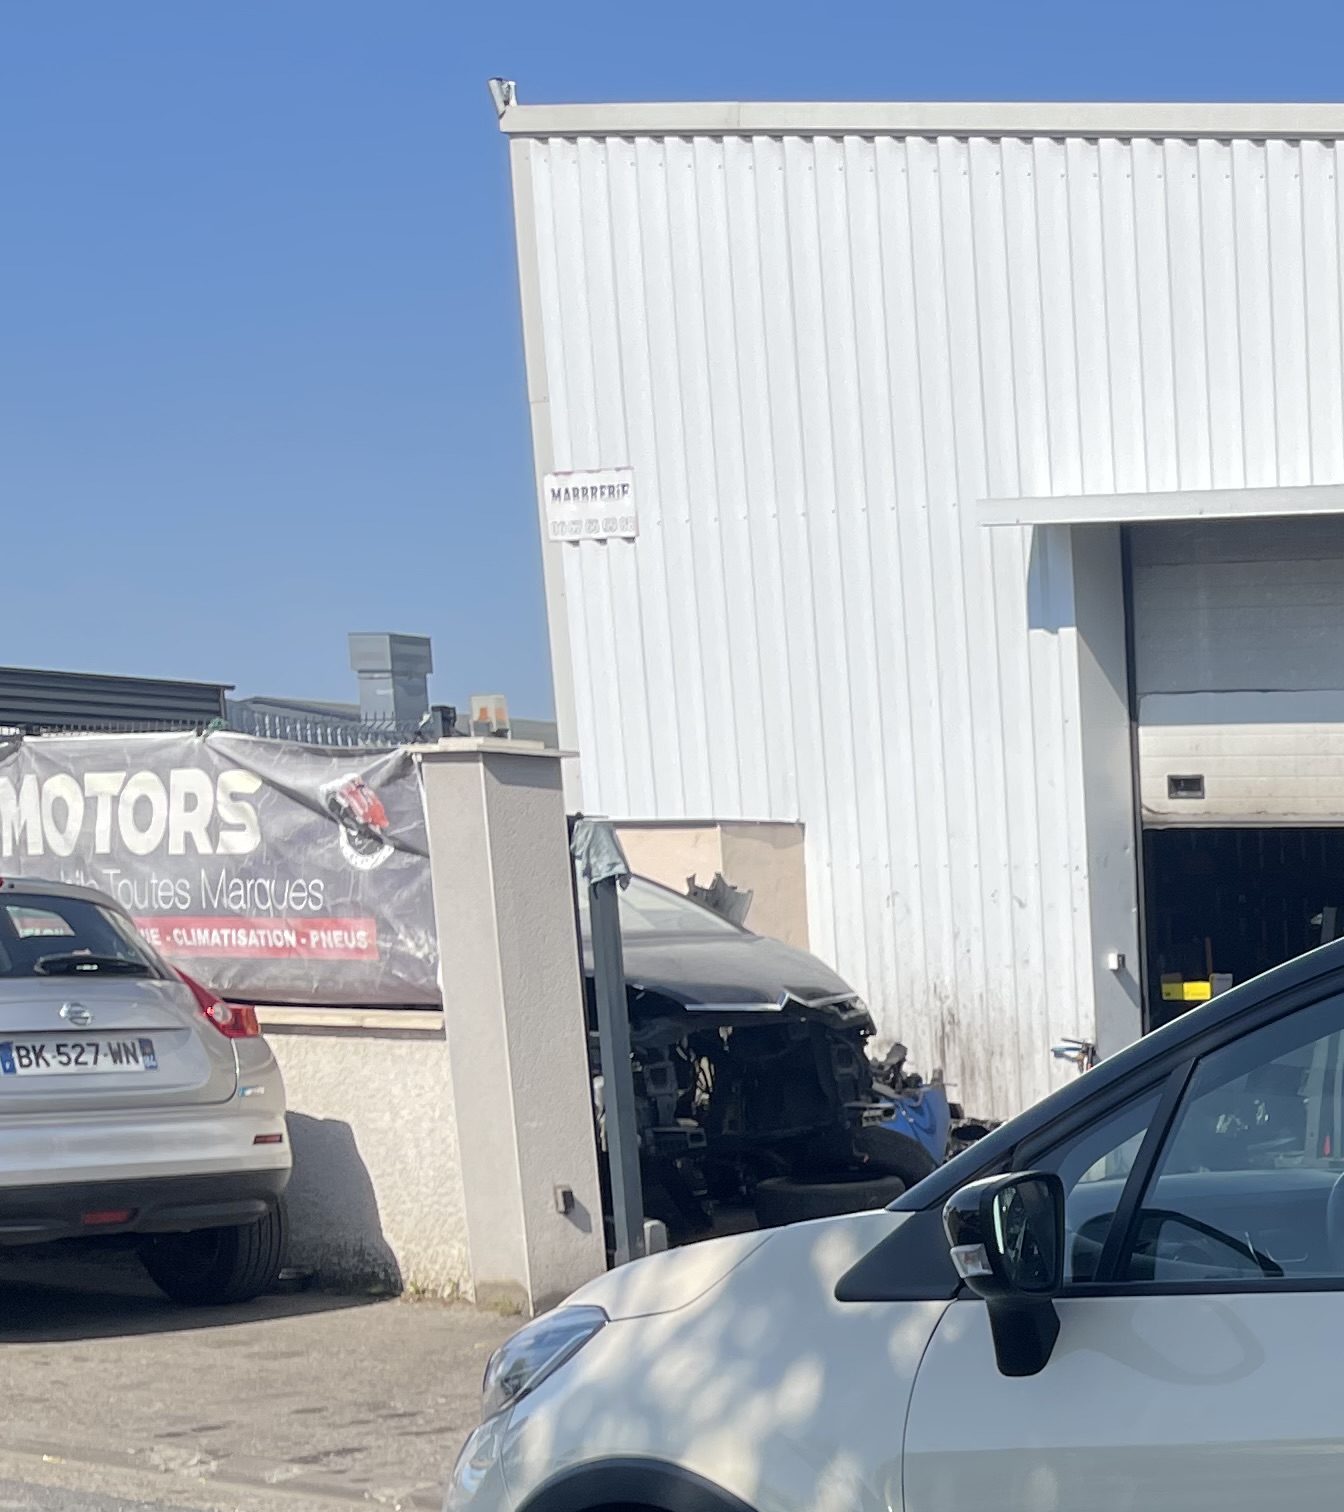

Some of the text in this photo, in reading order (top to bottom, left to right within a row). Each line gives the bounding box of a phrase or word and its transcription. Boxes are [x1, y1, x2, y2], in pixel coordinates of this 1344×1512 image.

[0, 767, 264, 857] MOTORS
[102, 869, 191, 910] Toutes
[201, 868, 325, 917] Marques
[173, 928, 297, 949] CLIMATISATION
[309, 930, 369, 950] PNEUS
